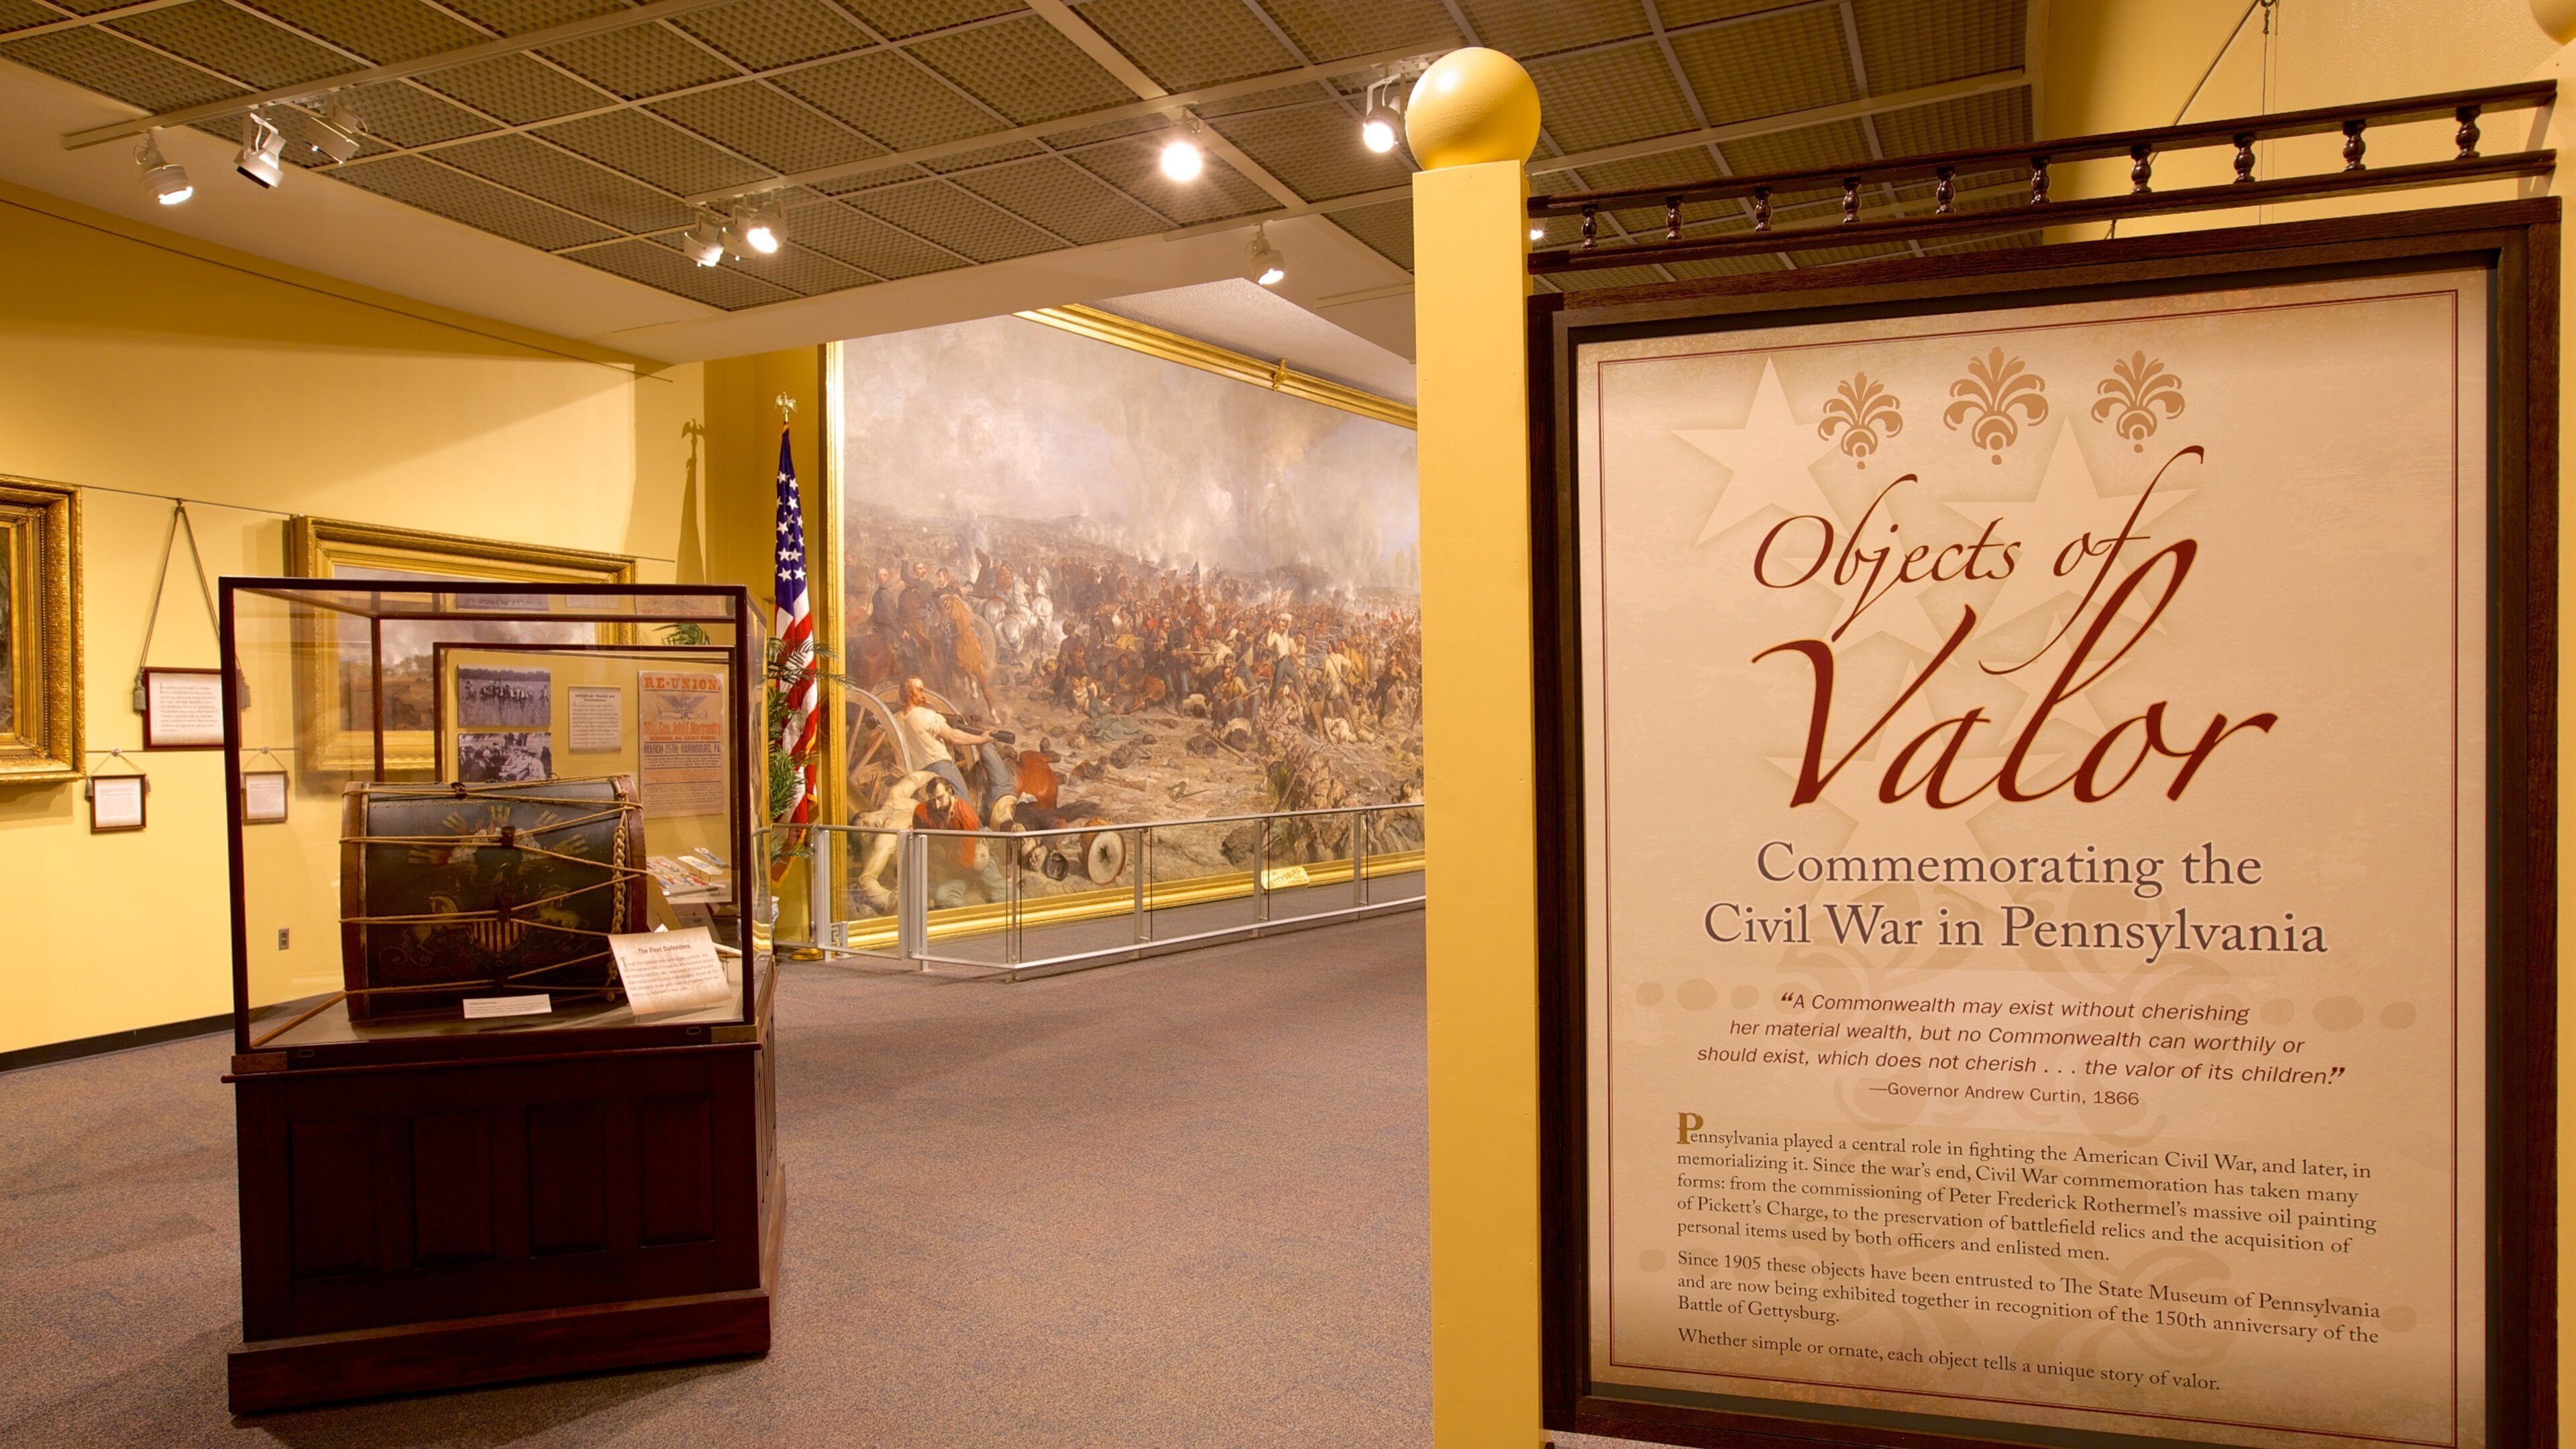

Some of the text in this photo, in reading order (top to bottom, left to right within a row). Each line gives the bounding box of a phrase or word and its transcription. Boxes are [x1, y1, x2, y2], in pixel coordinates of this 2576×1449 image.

[1753, 445, 2204, 675] Objects of
[1752, 539, 2278, 809] Valor
[1758, 842, 2261, 898] Commemorating the
[664, 944, 691, 952] Defenders
[1705, 903, 2328, 963] Civil War in Pennsylvania
[1730, 1020, 2305, 1055] her material wealth, but no Commonwealth can worthily or
[1812, 995, 1955, 1012] Commonwealth
[1962, 1002, 2003, 1017] may
[2009, 1000, 2054, 1016] exist
[2061, 1002, 2135, 1018] without
[2142, 1004, 2250, 1025] cherishing
[1697, 1046, 1757, 1062] should
[1764, 1049, 1809, 1066] exist,
[1818, 1051, 1868, 1066] which
[1876, 1053, 1921, 1068] does
[1929, 1055, 1959, 1069] not
[1966, 1055, 2036, 1072] cherish
[2086, 1060, 2116, 1075] the
[2126, 1062, 2175, 1077] valor
[2182, 1063, 2203, 1079] of
[2208, 1064, 2233, 1080] its
[1965, 1085, 2024, 1100] Andrew
[2030, 1088, 2085, 1105] Curtin,
[2094, 1091, 2139, 1105] 1866
[1676, 1112, 2371, 1180] Pennsylvania played a central role in fighting the American Civil War, and later, in
[1677, 1173, 1724, 1189] forms:
[1730, 1175, 1766, 1191] from
[1772, 1179, 1796, 1193] the
[1802, 1183, 1922, 1205] commissioning
[1927, 1187, 1946, 1201] of
[1949, 1187, 1991, 1204] Peter
[1997, 1191, 2077, 1210] Frederick
[2194, 1206, 2261, 1222] massive
[2269, 1208, 2292, 1224] oil
[2298, 1212, 2377, 1234] painting
[1678, 1154, 1788, 1174] memorializing
[1793, 1157, 1807, 1171] it.
[1814, 1157, 1855, 1173] Since
[1862, 1160, 1886, 1175] the
[1936, 1165, 1971, 1183] end,
[1976, 1165, 2016, 1182] Civil
[2021, 1168, 2057, 1184] War
[2063, 1176, 2208, 1193] commemoration
[2214, 1179, 2243, 1195] has
[2251, 1182, 2300, 1199] taken
[2307, 1191, 2358, 1208] many
[1678, 1196, 1695, 1210] of
[1767, 1201, 1827, 1222] Charge,
[1833, 1208, 1847, 1219] to
[1854, 1206, 1878, 1221] the
[1884, 1214, 1982, 1228] preservation
[1989, 1215, 2008, 1229] of
[2011, 1216, 2095, 1235] battlefield
[2102, 1222, 2145, 1238] relics
[2152, 1226, 2184, 1241] and
[2190, 1228, 2218, 1244] the
[2225, 1234, 2324, 1251] acquisition
[2331, 1238, 2353, 1252] of
[1678, 1222, 2108, 1260] personal items used by both officers and enlisted men.
[1678, 1250, 2380, 1318] Since 1905 these objects have been entrusted to The State Museum of Pennsylvania
[1678, 1275, 2378, 1343] and are now being exhibited together in recognition of the 150th anniversary of the
[1678, 1295, 1839, 1326] Battle of Gettysburg.
[1678, 1328, 2219, 1390] Whether simple or ornate, each object tells a unique story of valor.
